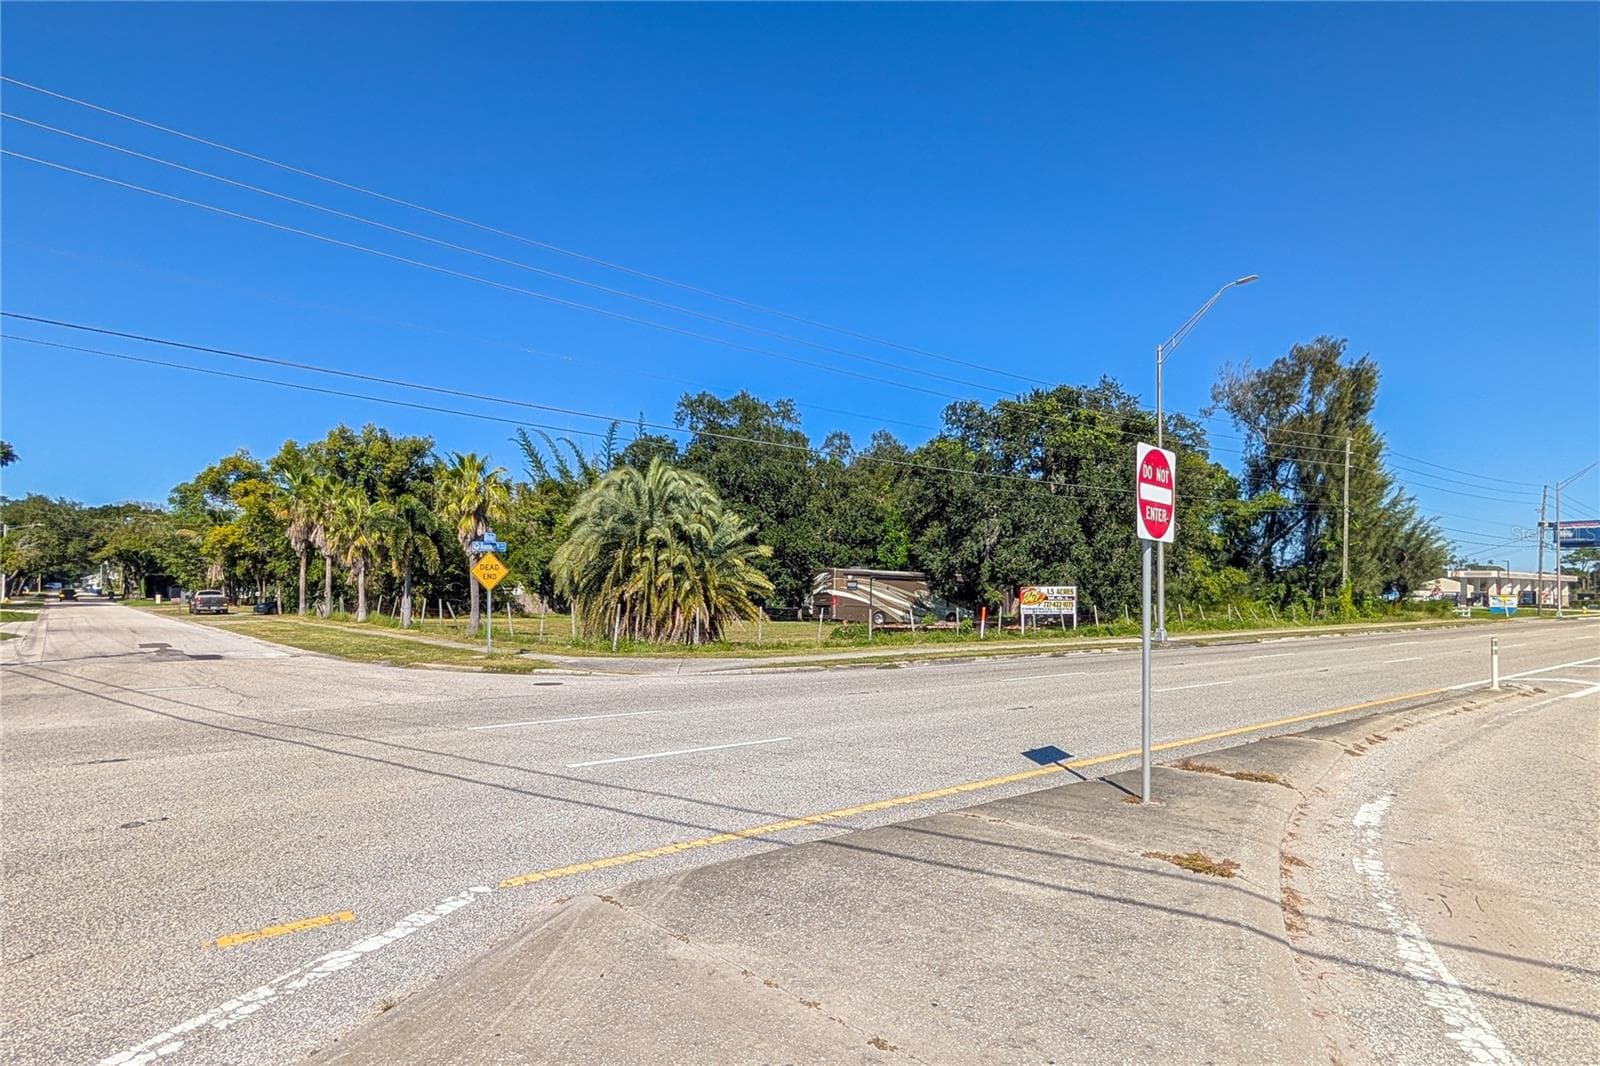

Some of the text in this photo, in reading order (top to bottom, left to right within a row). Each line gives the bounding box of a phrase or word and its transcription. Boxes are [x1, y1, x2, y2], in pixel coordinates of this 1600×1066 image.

[1142, 463, 1169, 484] DO NOT
[1146, 506, 1169, 523] ENTER
[479, 563, 500, 571] DEAD
